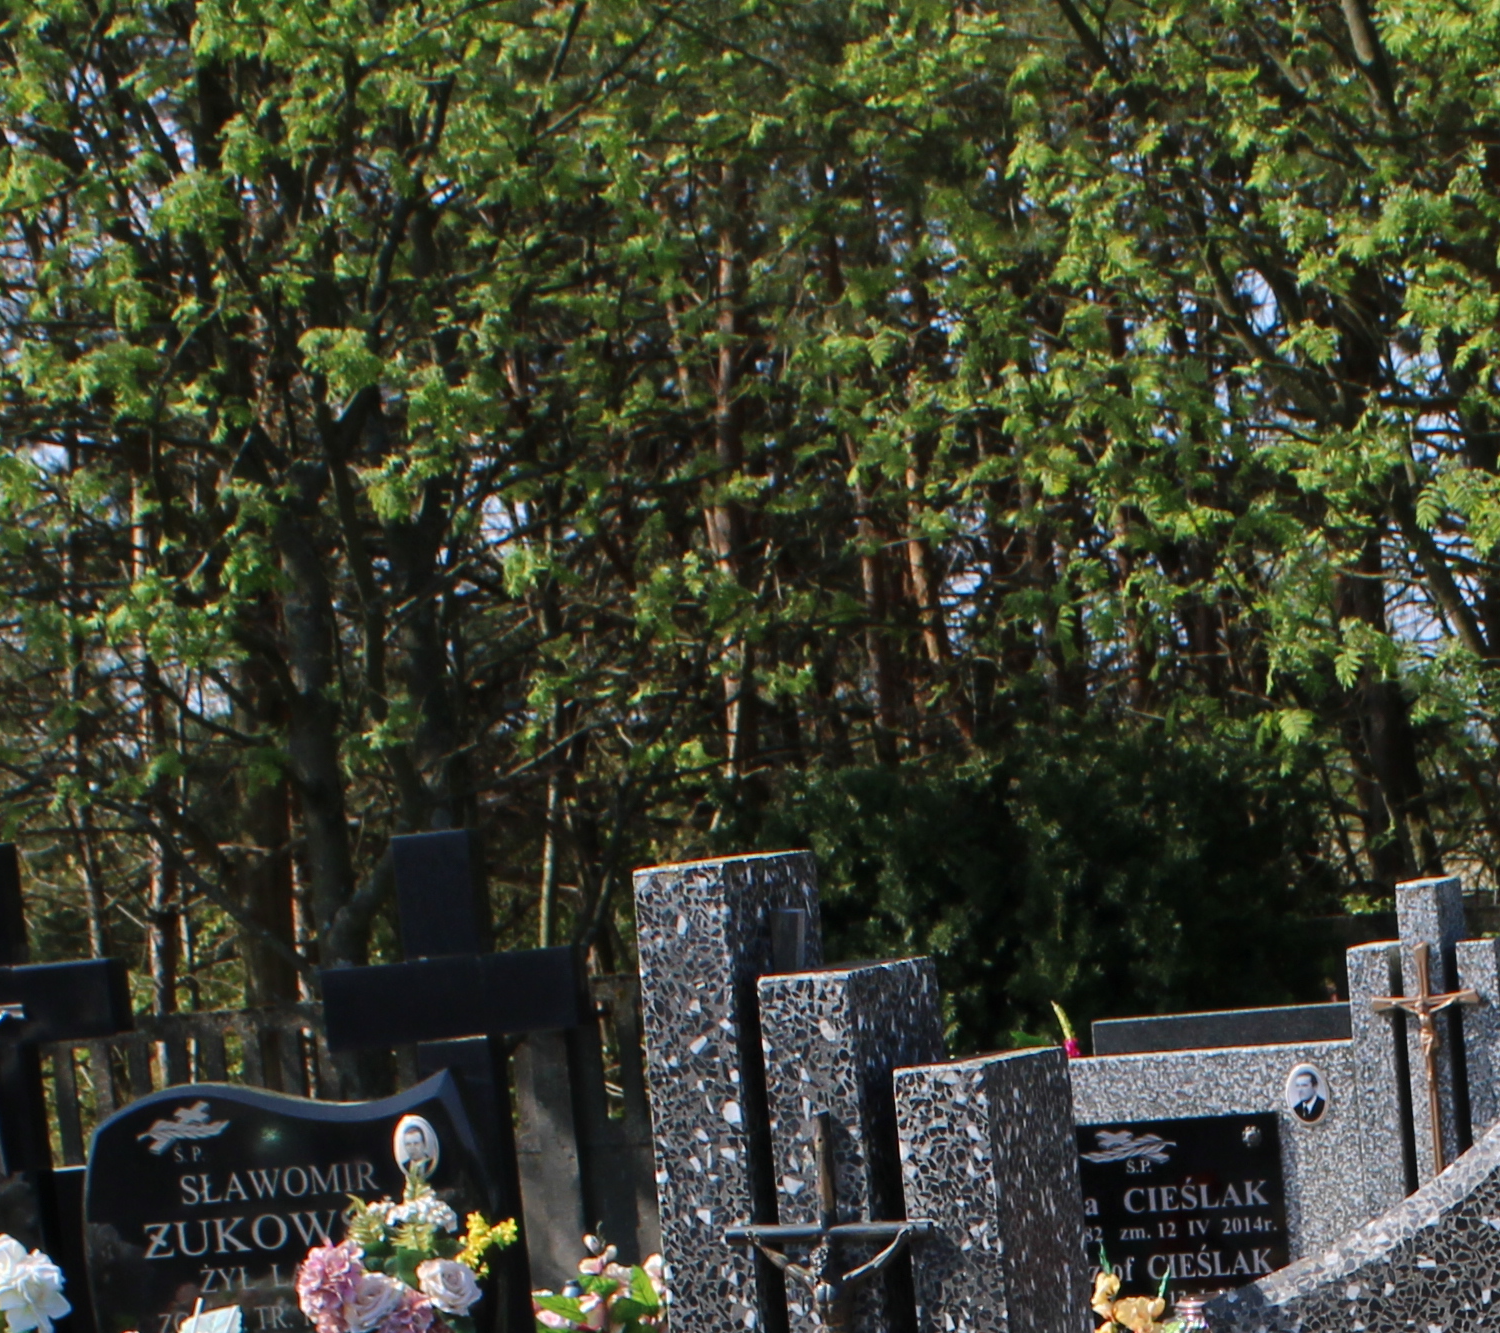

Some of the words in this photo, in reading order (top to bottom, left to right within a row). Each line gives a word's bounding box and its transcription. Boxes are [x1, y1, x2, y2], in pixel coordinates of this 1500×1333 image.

[179, 1161, 381, 1205] SŁAWOMIR
[1123, 1177, 1269, 1214] CIEŚLAK
[1119, 1227, 1151, 1241] zm.
[1158, 1222, 1177, 1239] 12
[1188, 1219, 1211, 1237] IV
[1221, 1215, 1278, 1235] 2014r.
[199, 1263, 254, 1293] ŻYŁ
[1147, 1244, 1274, 1281] CIEŚLAK
